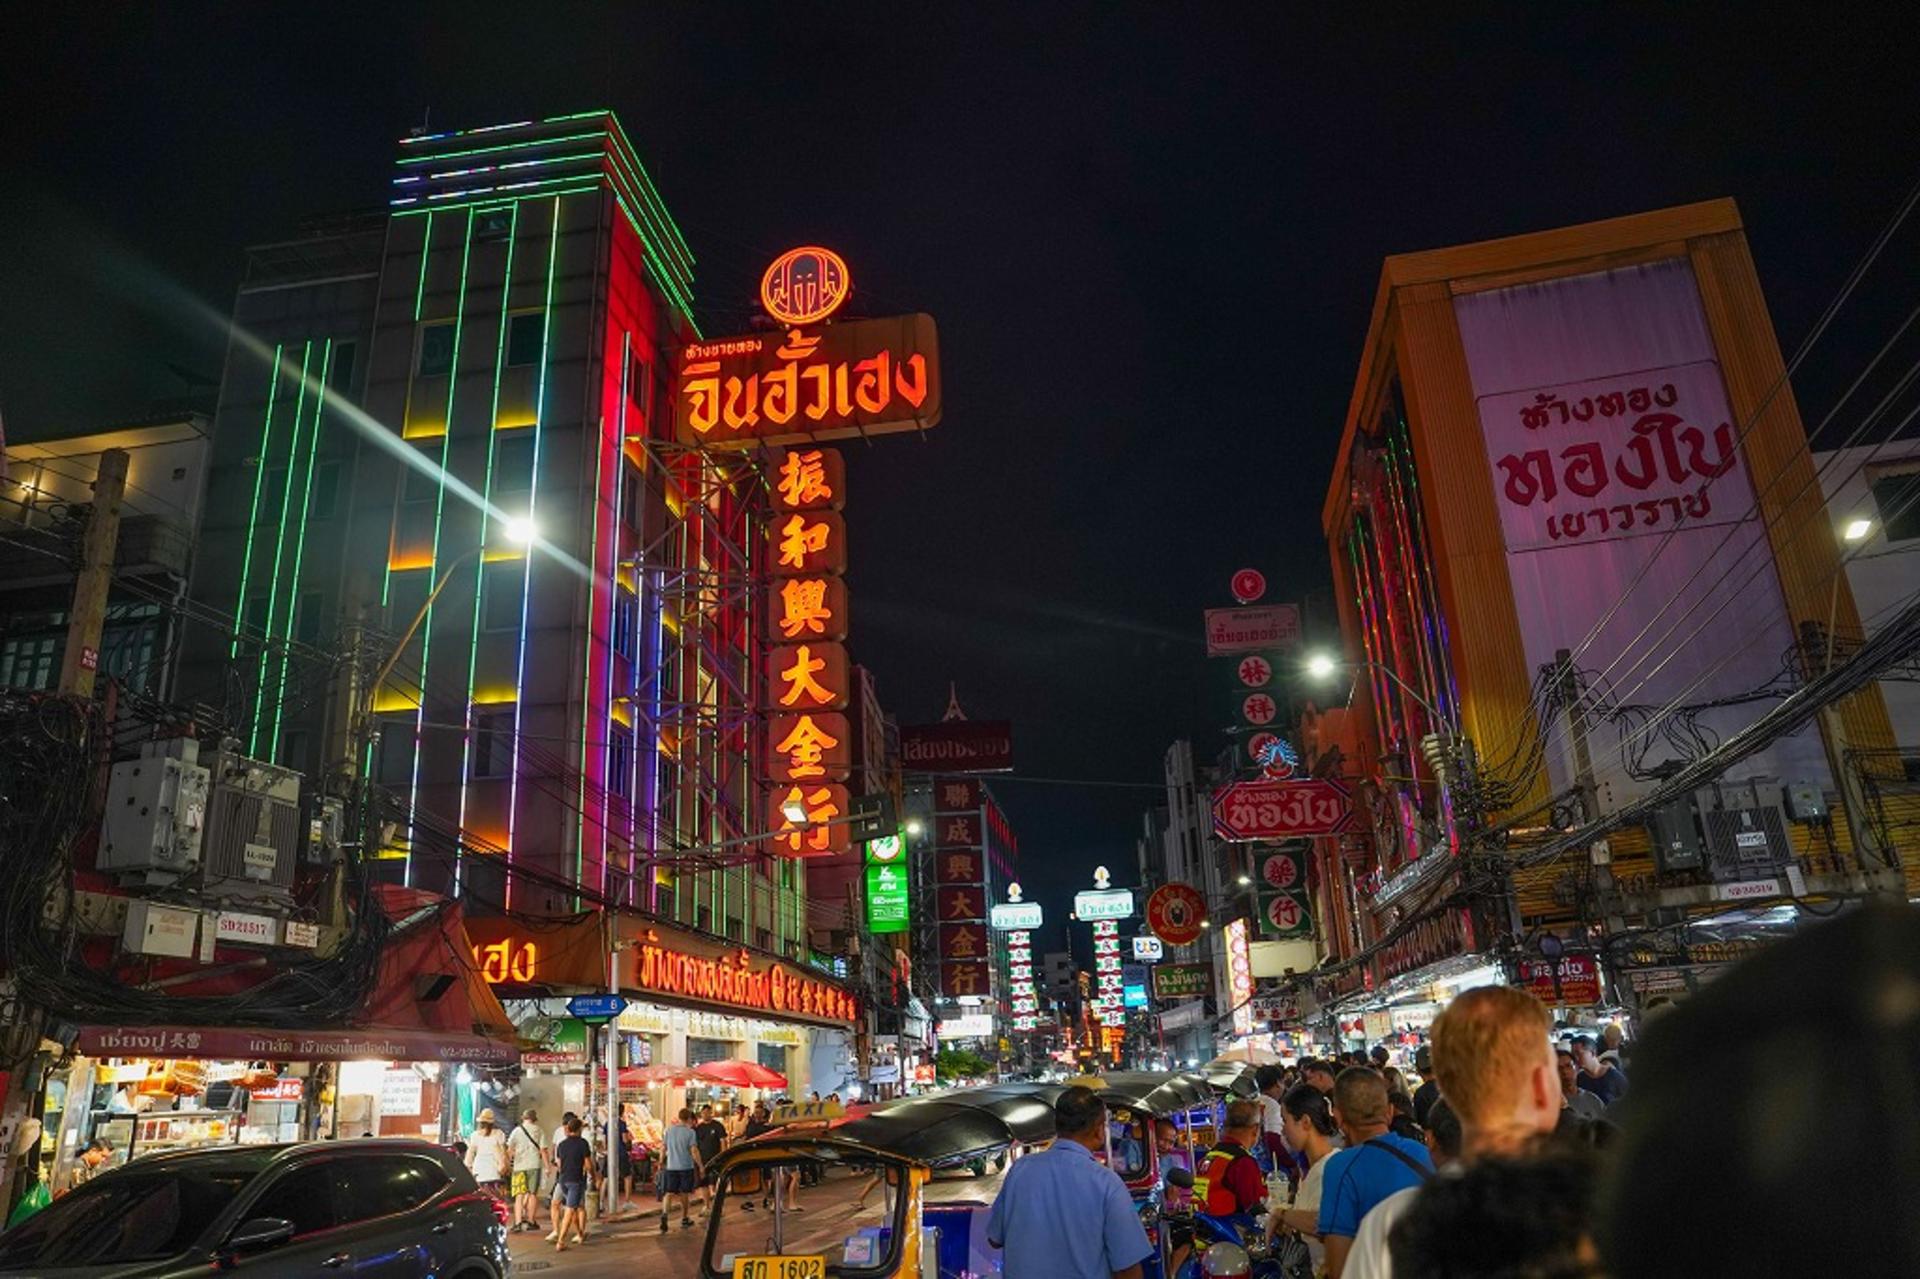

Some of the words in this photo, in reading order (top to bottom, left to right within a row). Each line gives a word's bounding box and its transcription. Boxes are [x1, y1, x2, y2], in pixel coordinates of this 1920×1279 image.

[686, 340, 762, 360] ห้างขายทอง
[682, 329, 928, 433] จินฮั้วเฮง
[1519, 384, 1678, 430] ห้างทอง
[1496, 412, 1737, 507] ทองใบ
[1547, 490, 1712, 541] เยาวราช
[776, 450, 838, 851] 振和興大金行
[1231, 789, 1341, 829] ทองใบ
[1234, 788, 1287, 804] ห้างทอง
[945, 784, 979, 994] 聯成興大金行
[779, 1102, 824, 1119] TAXI
